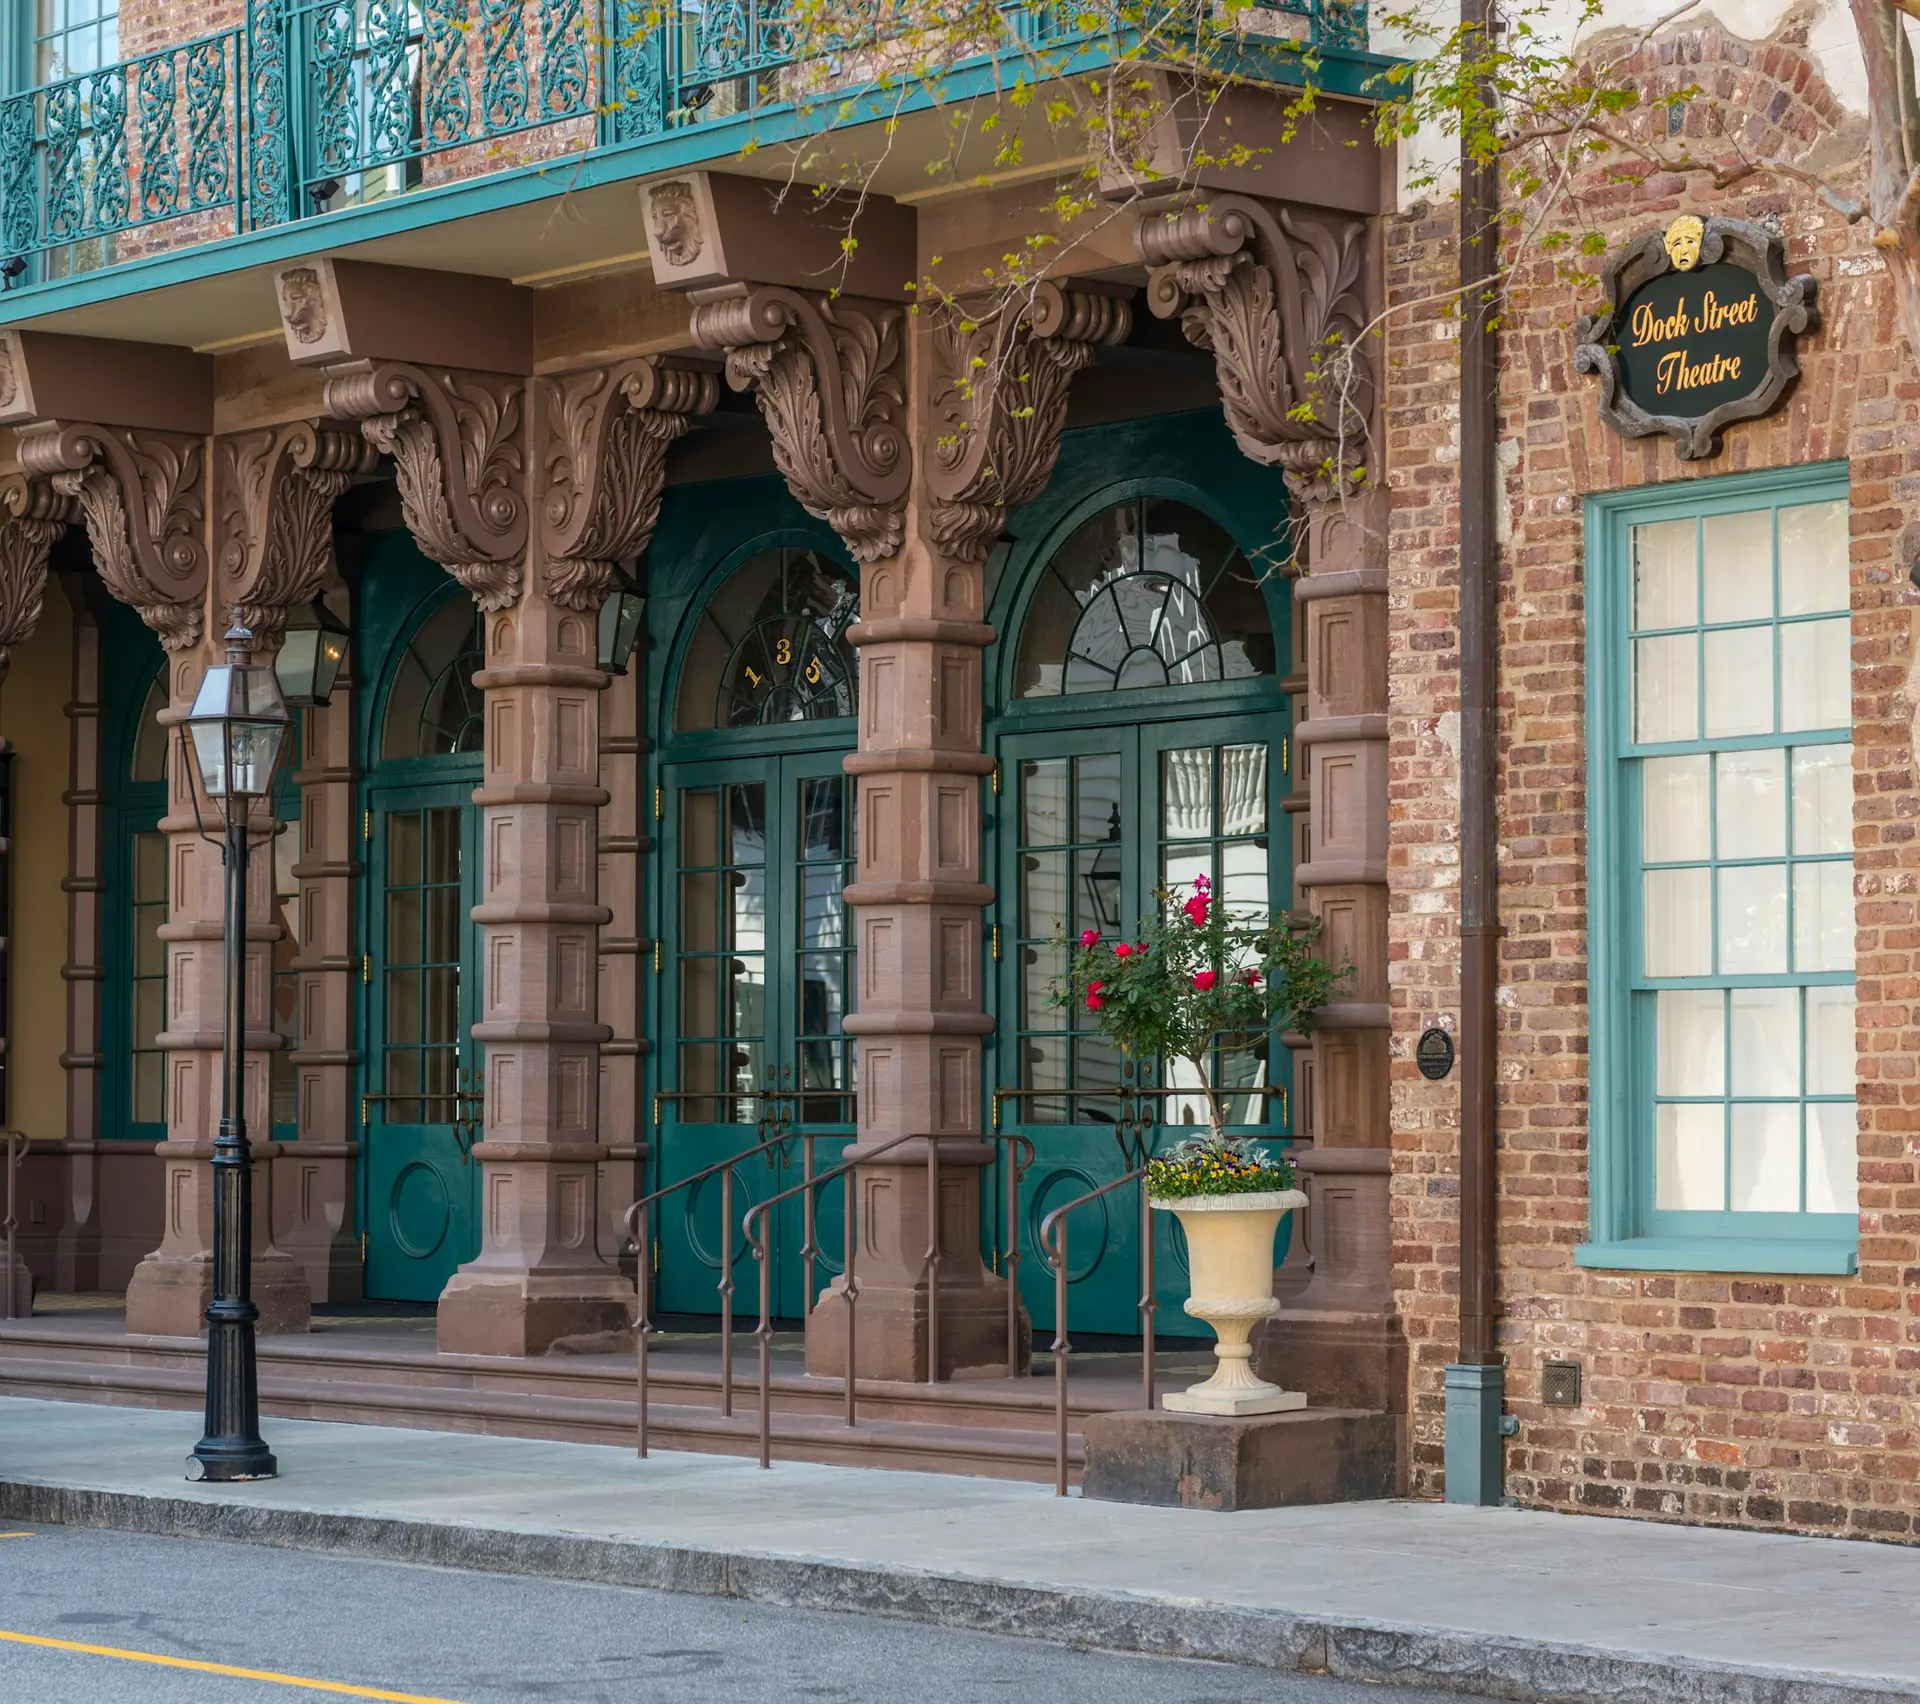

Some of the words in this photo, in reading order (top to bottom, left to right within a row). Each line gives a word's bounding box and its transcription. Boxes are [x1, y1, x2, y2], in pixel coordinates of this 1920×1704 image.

[1632, 296, 1690, 347] Dock
[1694, 290, 1758, 333] Street
[1656, 350, 1741, 395] Theatre
